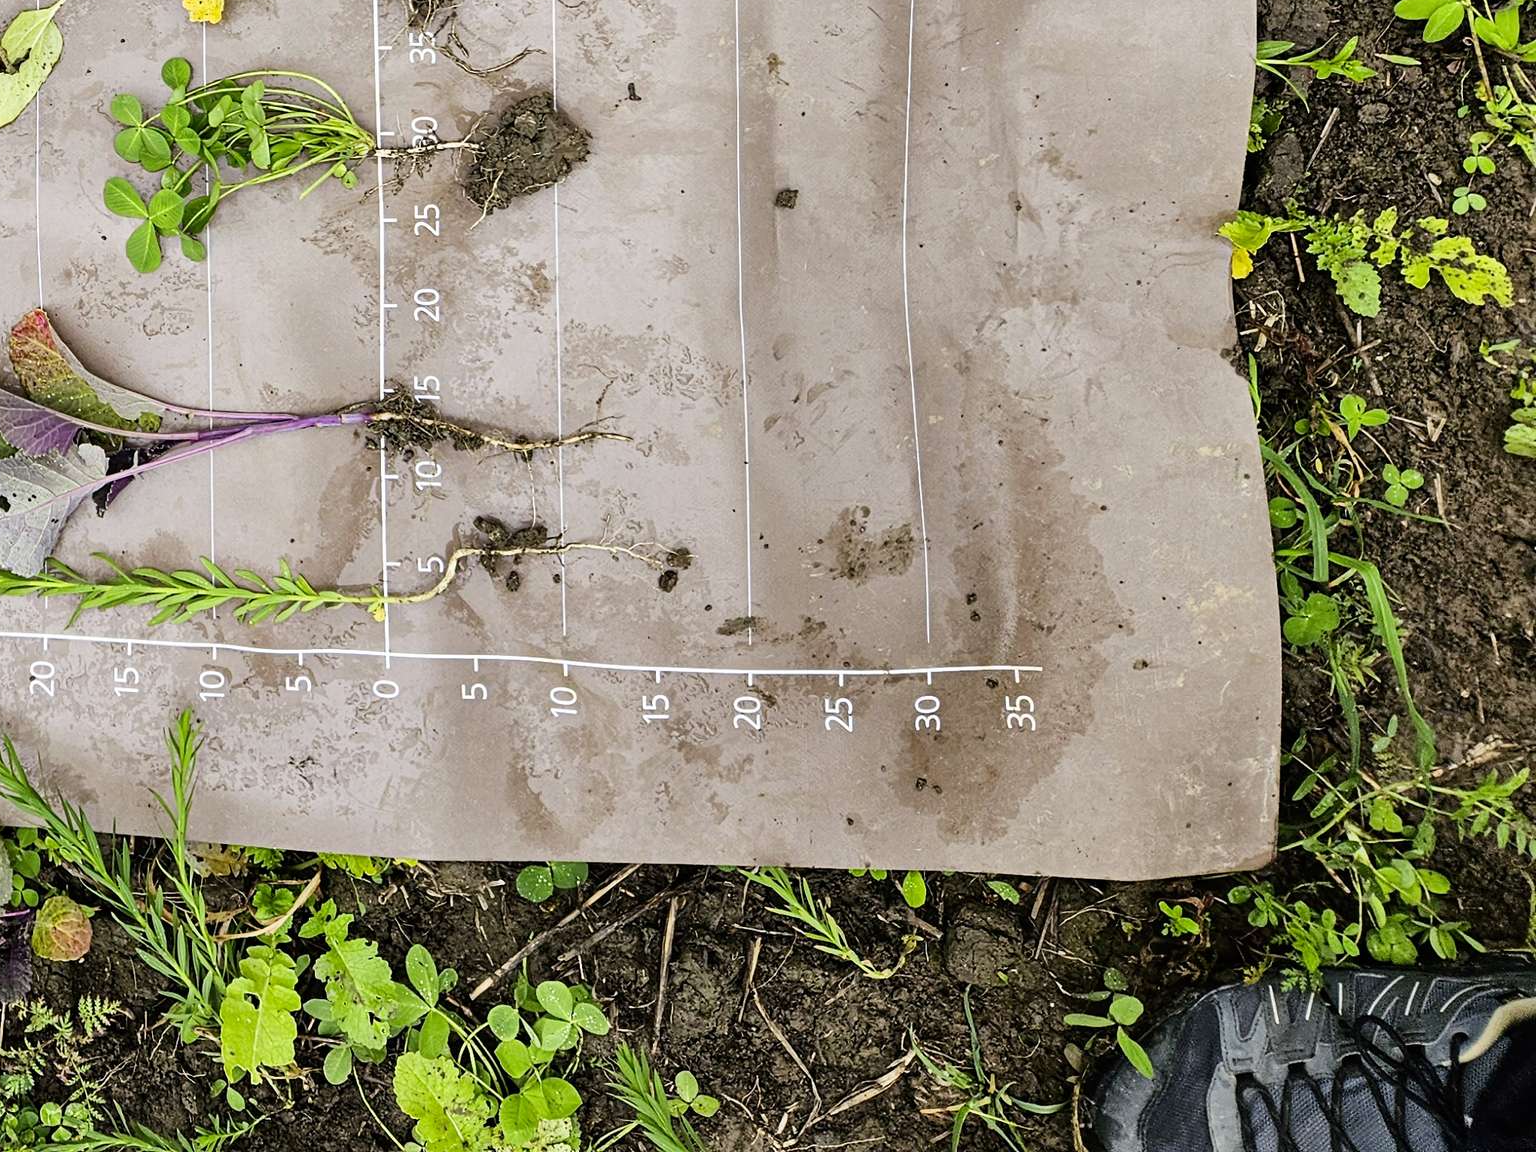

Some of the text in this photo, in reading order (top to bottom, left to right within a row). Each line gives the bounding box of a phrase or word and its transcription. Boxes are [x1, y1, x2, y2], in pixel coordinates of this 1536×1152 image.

[409, 31, 436, 64] 35
[414, 204, 440, 236] 25
[413, 288, 440, 322] 20
[413, 375, 440, 403] 15
[415, 461, 442, 491] 10
[417, 557, 444, 573] 5
[29, 660, 55, 697] 20
[113, 667, 140, 697] 15
[199, 670, 225, 702] 10
[285, 676, 312, 692] 5
[372, 679, 400, 699] 0
[461, 683, 488, 700] 5
[550, 687, 577, 717] 10
[642, 694, 670, 724] 15
[733, 696, 761, 730] 20
[824, 697, 853, 732] 25
[914, 695, 941, 731] 30
[1005, 695, 1036, 731] 35
